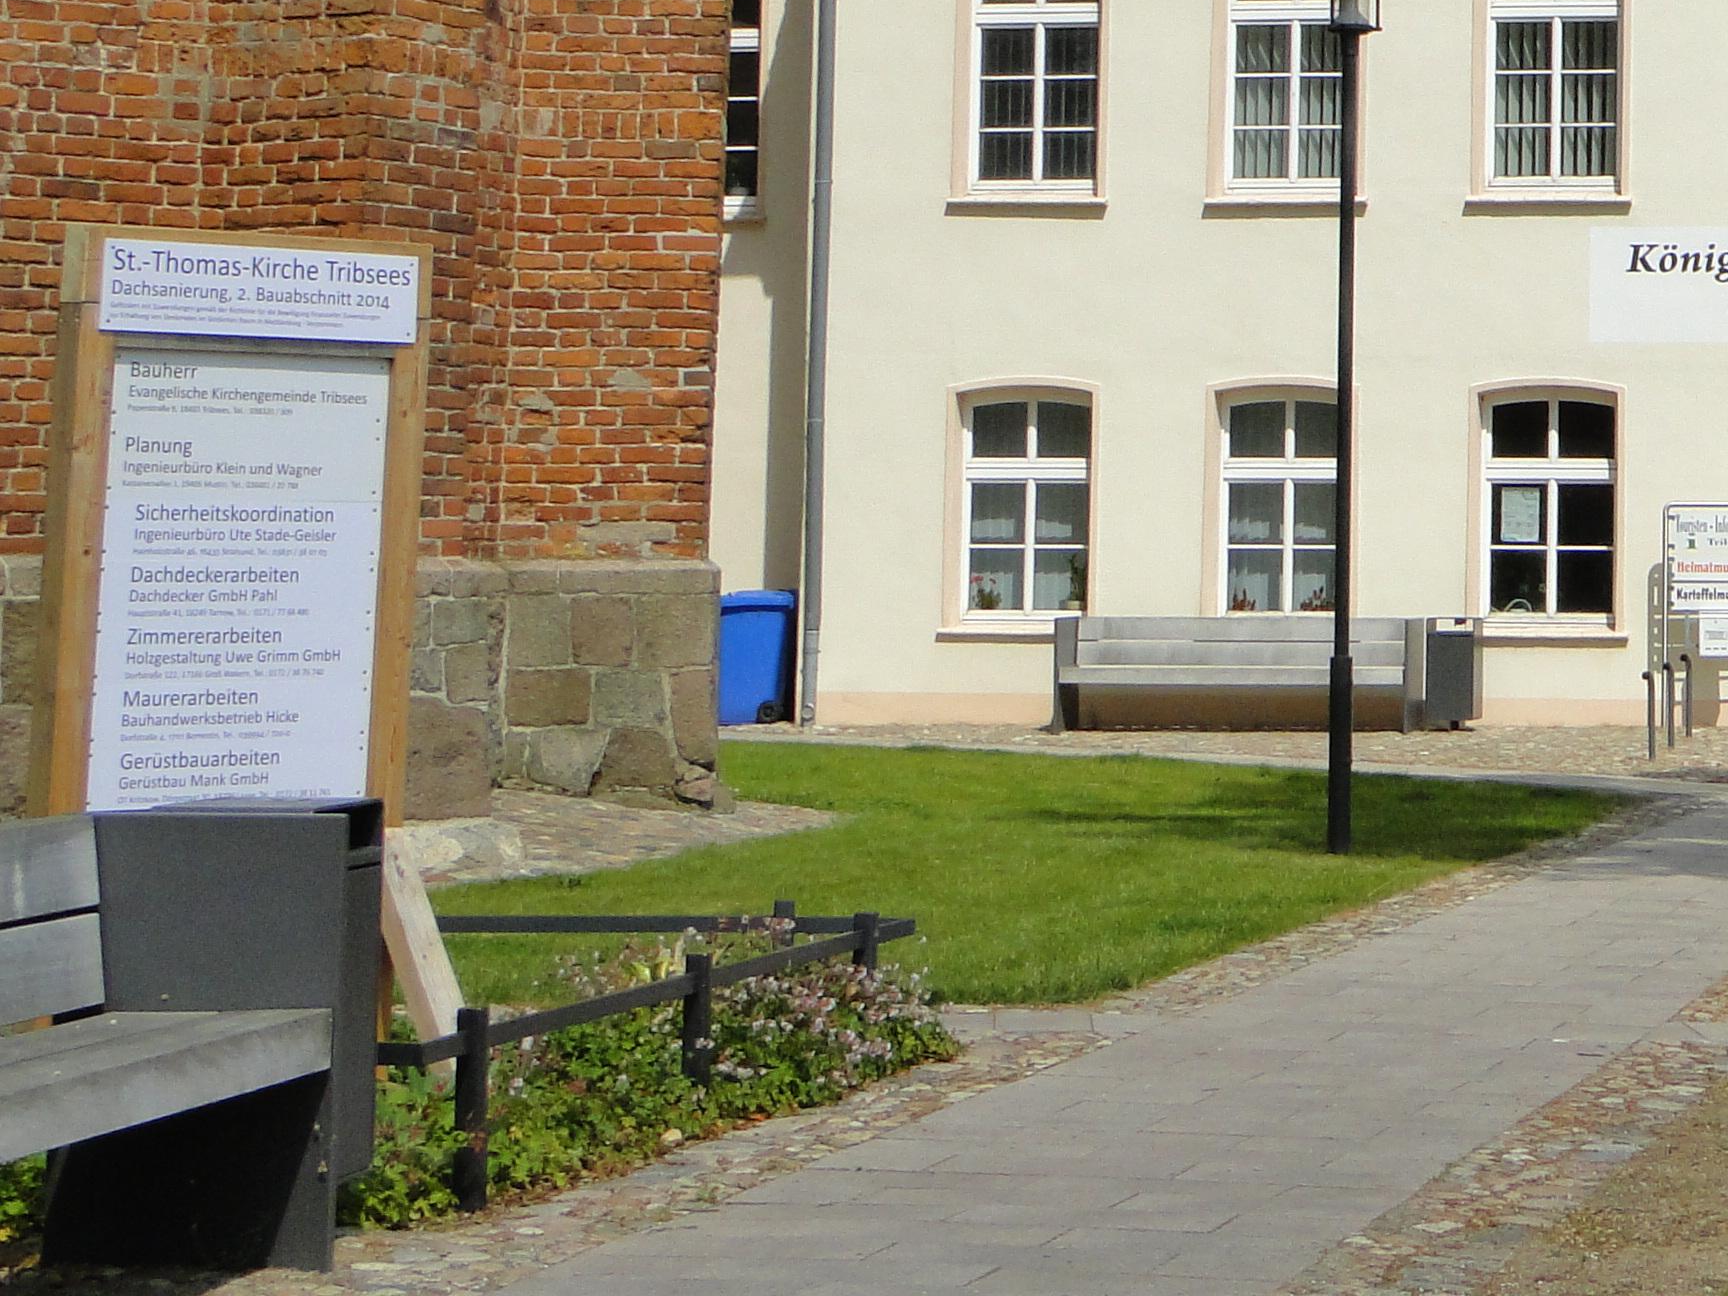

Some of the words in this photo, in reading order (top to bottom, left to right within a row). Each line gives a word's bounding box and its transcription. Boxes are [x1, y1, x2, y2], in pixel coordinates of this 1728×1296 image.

[113, 248, 319, 281] St.-Thomas-Kirche
[326, 260, 411, 286] Tribsees
[111, 279, 232, 303] Dachsanierung,
[237, 288, 250, 301] 2.
[256, 287, 352, 305] Bauabschnitt
[356, 294, 390, 309] 2014
[130, 361, 198, 380] Bauherr
[128, 385, 209, 401] Evangelische
[211, 387, 317, 404] Kirchengemeinde
[320, 390, 368, 405] Tribsees
[125, 436, 193, 458] Planung
[123, 461, 213, 475] Ingenieurbüro
[216, 461, 247, 475] Klein
[250, 462, 273, 475] und
[276, 463, 323, 478] Wagner
[135, 503, 335, 523] Sicherheitskoordination
[134, 528, 226, 544] Ingenieurbüro
[230, 529, 251, 541] Ute
[255, 529, 337, 542] Stade-Geisler
[131, 566, 300, 584] Dachdeckerarbeiten
[129, 589, 205, 603] Dachdecker
[208, 589, 248, 602] GmbH
[251, 589, 278, 602] Pahl
[127, 627, 283, 645] Zimmererarbeiten
[126, 651, 222, 667] Holzgestaltung
[225, 650, 253, 664] Uwe
[257, 650, 299, 663] Grimm
[302, 649, 342, 662] GmbH
[123, 689, 259, 707] Maurerarbeiten
[121, 711, 263, 727] Bauhandwerksbetrieb
[265, 710, 300, 724] Hicke
[120, 750, 281, 770] Gerüstbauarbeiten
[118, 775, 187, 790] Gerüstbau
[190, 774, 226, 787] Mank
[230, 772, 269, 786] GmbH
